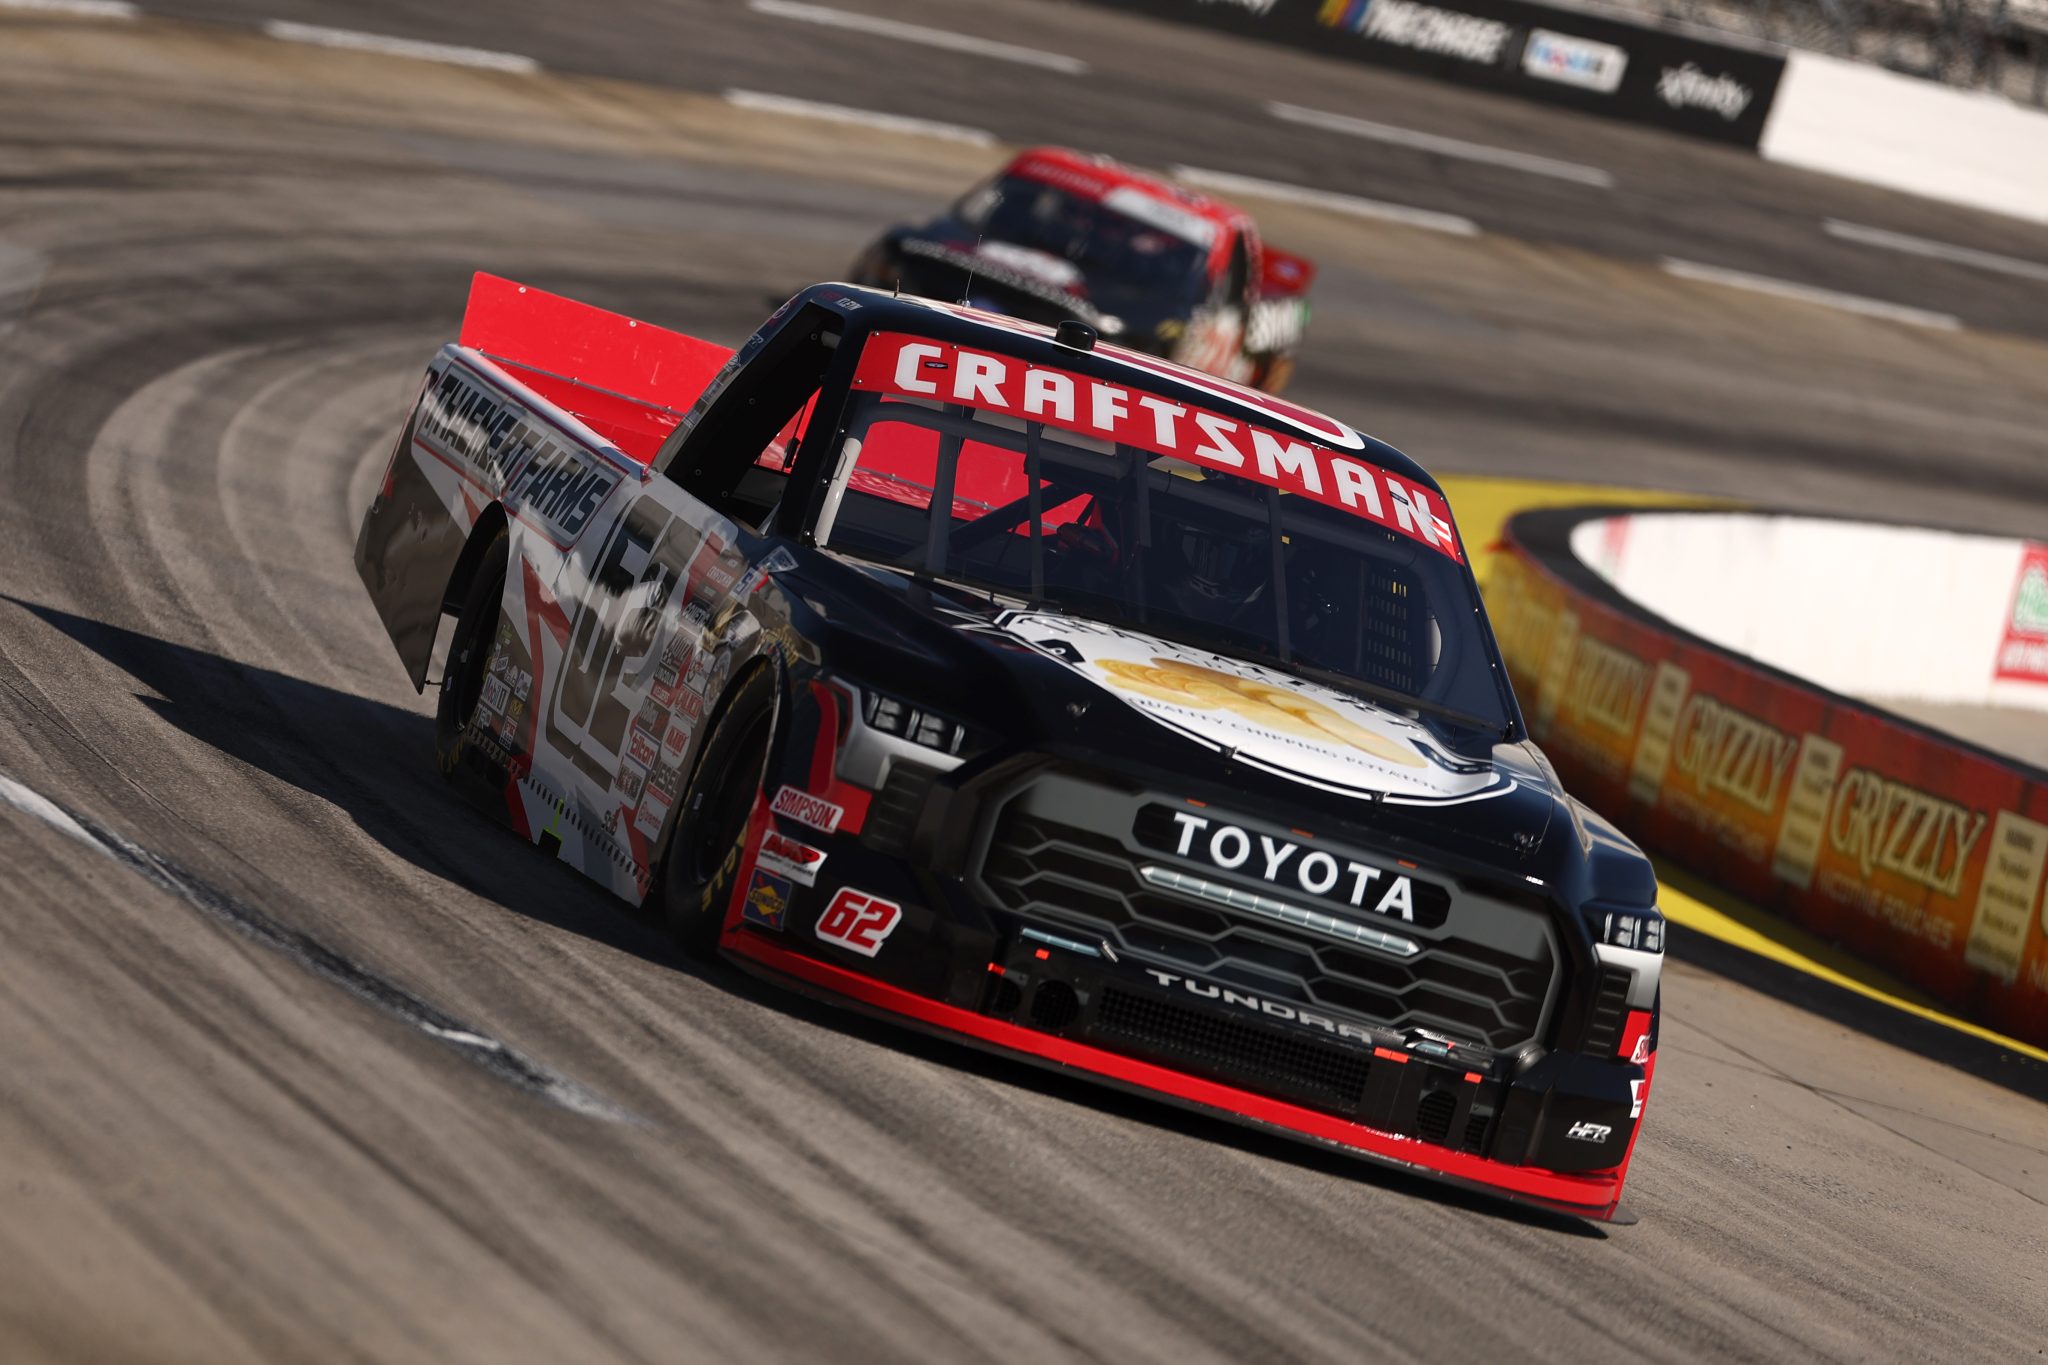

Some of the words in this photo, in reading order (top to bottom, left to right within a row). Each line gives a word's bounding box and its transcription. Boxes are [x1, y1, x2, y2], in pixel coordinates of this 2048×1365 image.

[424, 373, 536, 486] THAEMERT
[514, 440, 611, 535] FARMS
[894, 342, 1441, 547] CRAFTSMAN
[775, 788, 834, 831] SIMPSON
[1675, 694, 1798, 816] GRIZZLY
[1174, 811, 1415, 923] TOYOTA
[1829, 767, 1988, 901] GRIZZLY
[816, 887, 901, 955] 62
[1146, 968, 1373, 1044] TUNDRA
[1568, 1120, 1611, 1141] HFR
